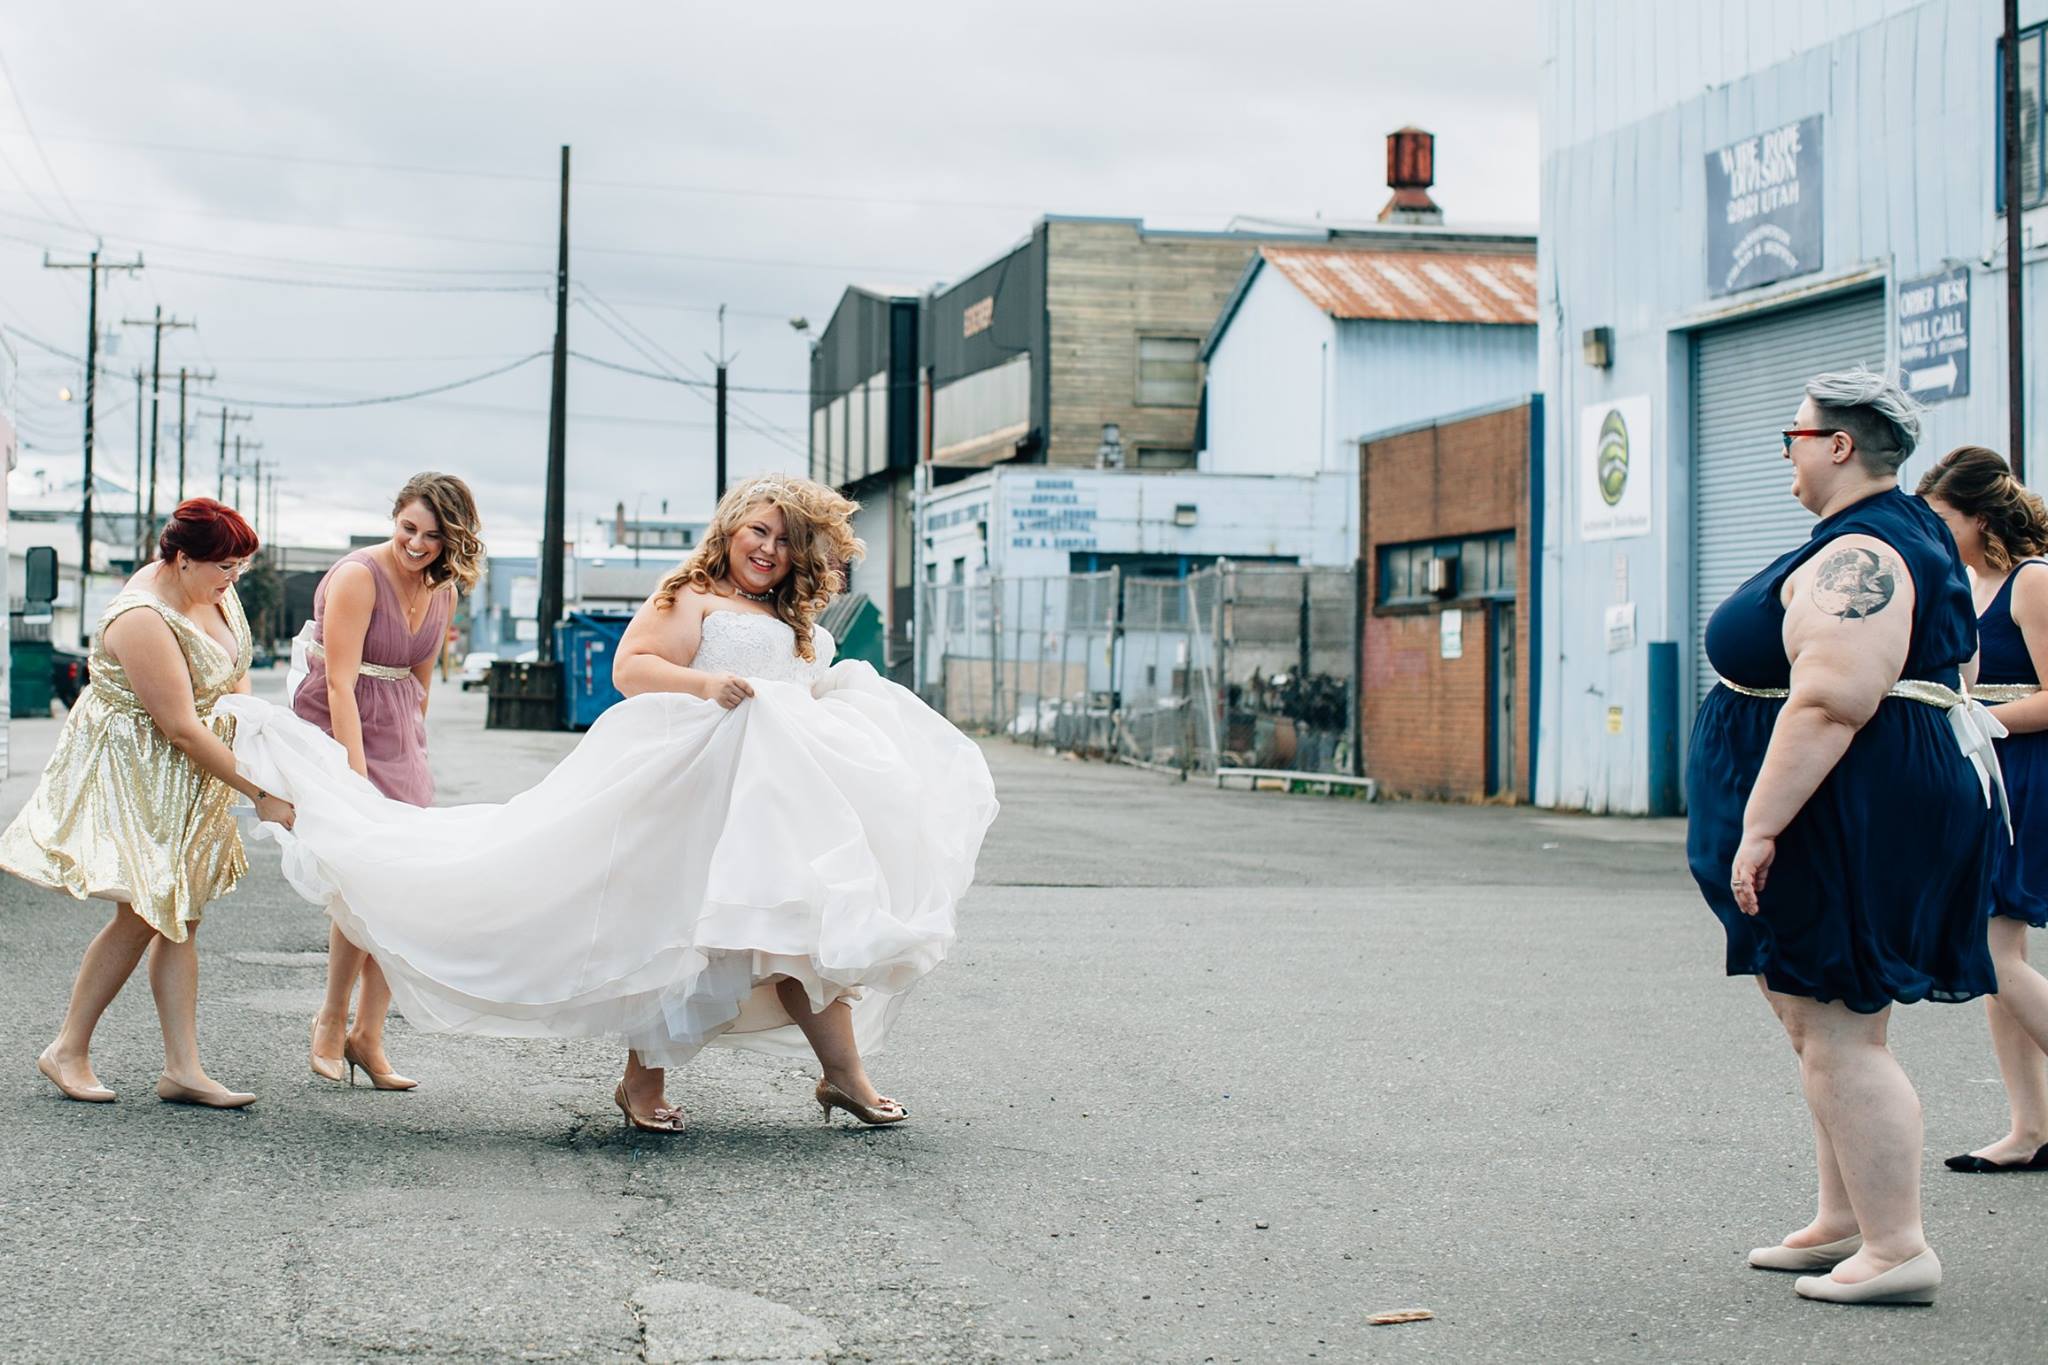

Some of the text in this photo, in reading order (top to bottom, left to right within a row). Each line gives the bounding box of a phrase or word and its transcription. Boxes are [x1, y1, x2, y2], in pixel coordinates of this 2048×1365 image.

[1720, 124, 1802, 176] WIRE ROPE
[1731, 153, 1798, 199] DIVISION
[1761, 180, 1800, 215] UTAH
[1938, 277, 1968, 309] DESK
[1901, 310, 1965, 348] WILL CALL
